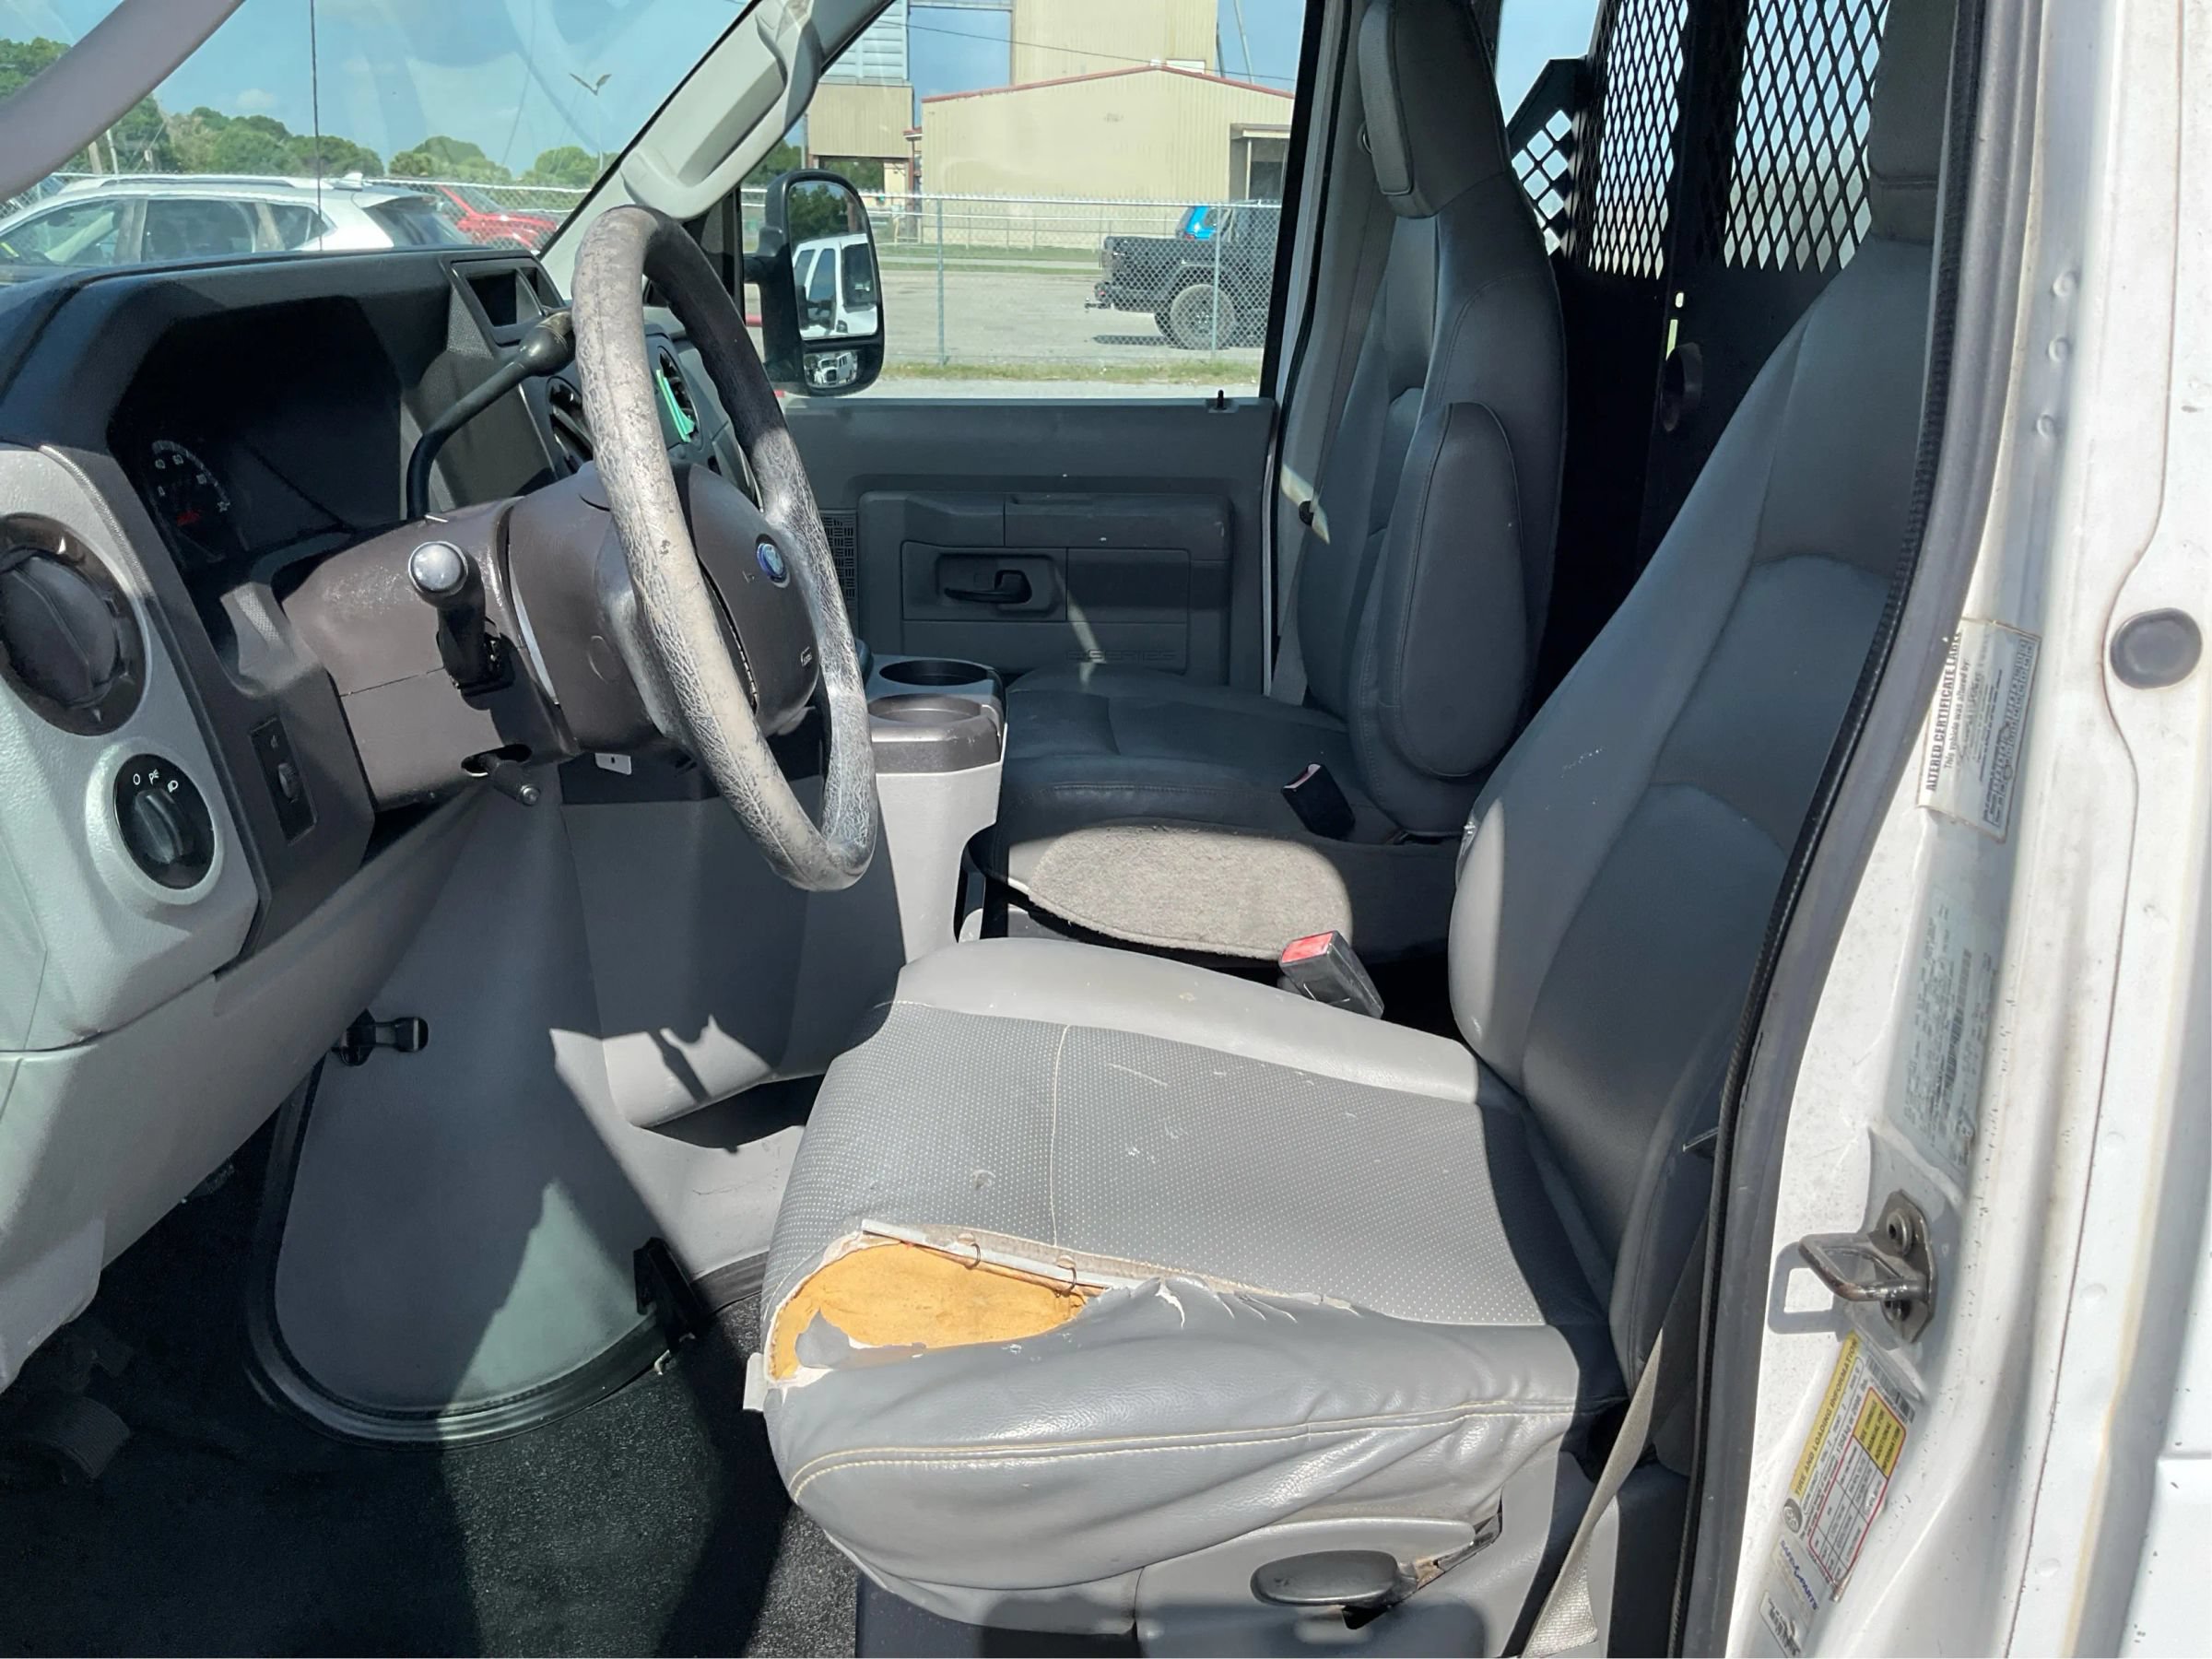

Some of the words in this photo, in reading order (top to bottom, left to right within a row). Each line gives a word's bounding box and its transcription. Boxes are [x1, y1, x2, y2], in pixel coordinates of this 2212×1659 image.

[1934, 667, 1956, 742] CERTIFICATE
[1794, 1474, 1806, 1496] TIRE
[1804, 1452, 1815, 1474] AND
[1813, 1407, 1832, 1451] LOADING
[1830, 1338, 1858, 1408] INFORMATION
